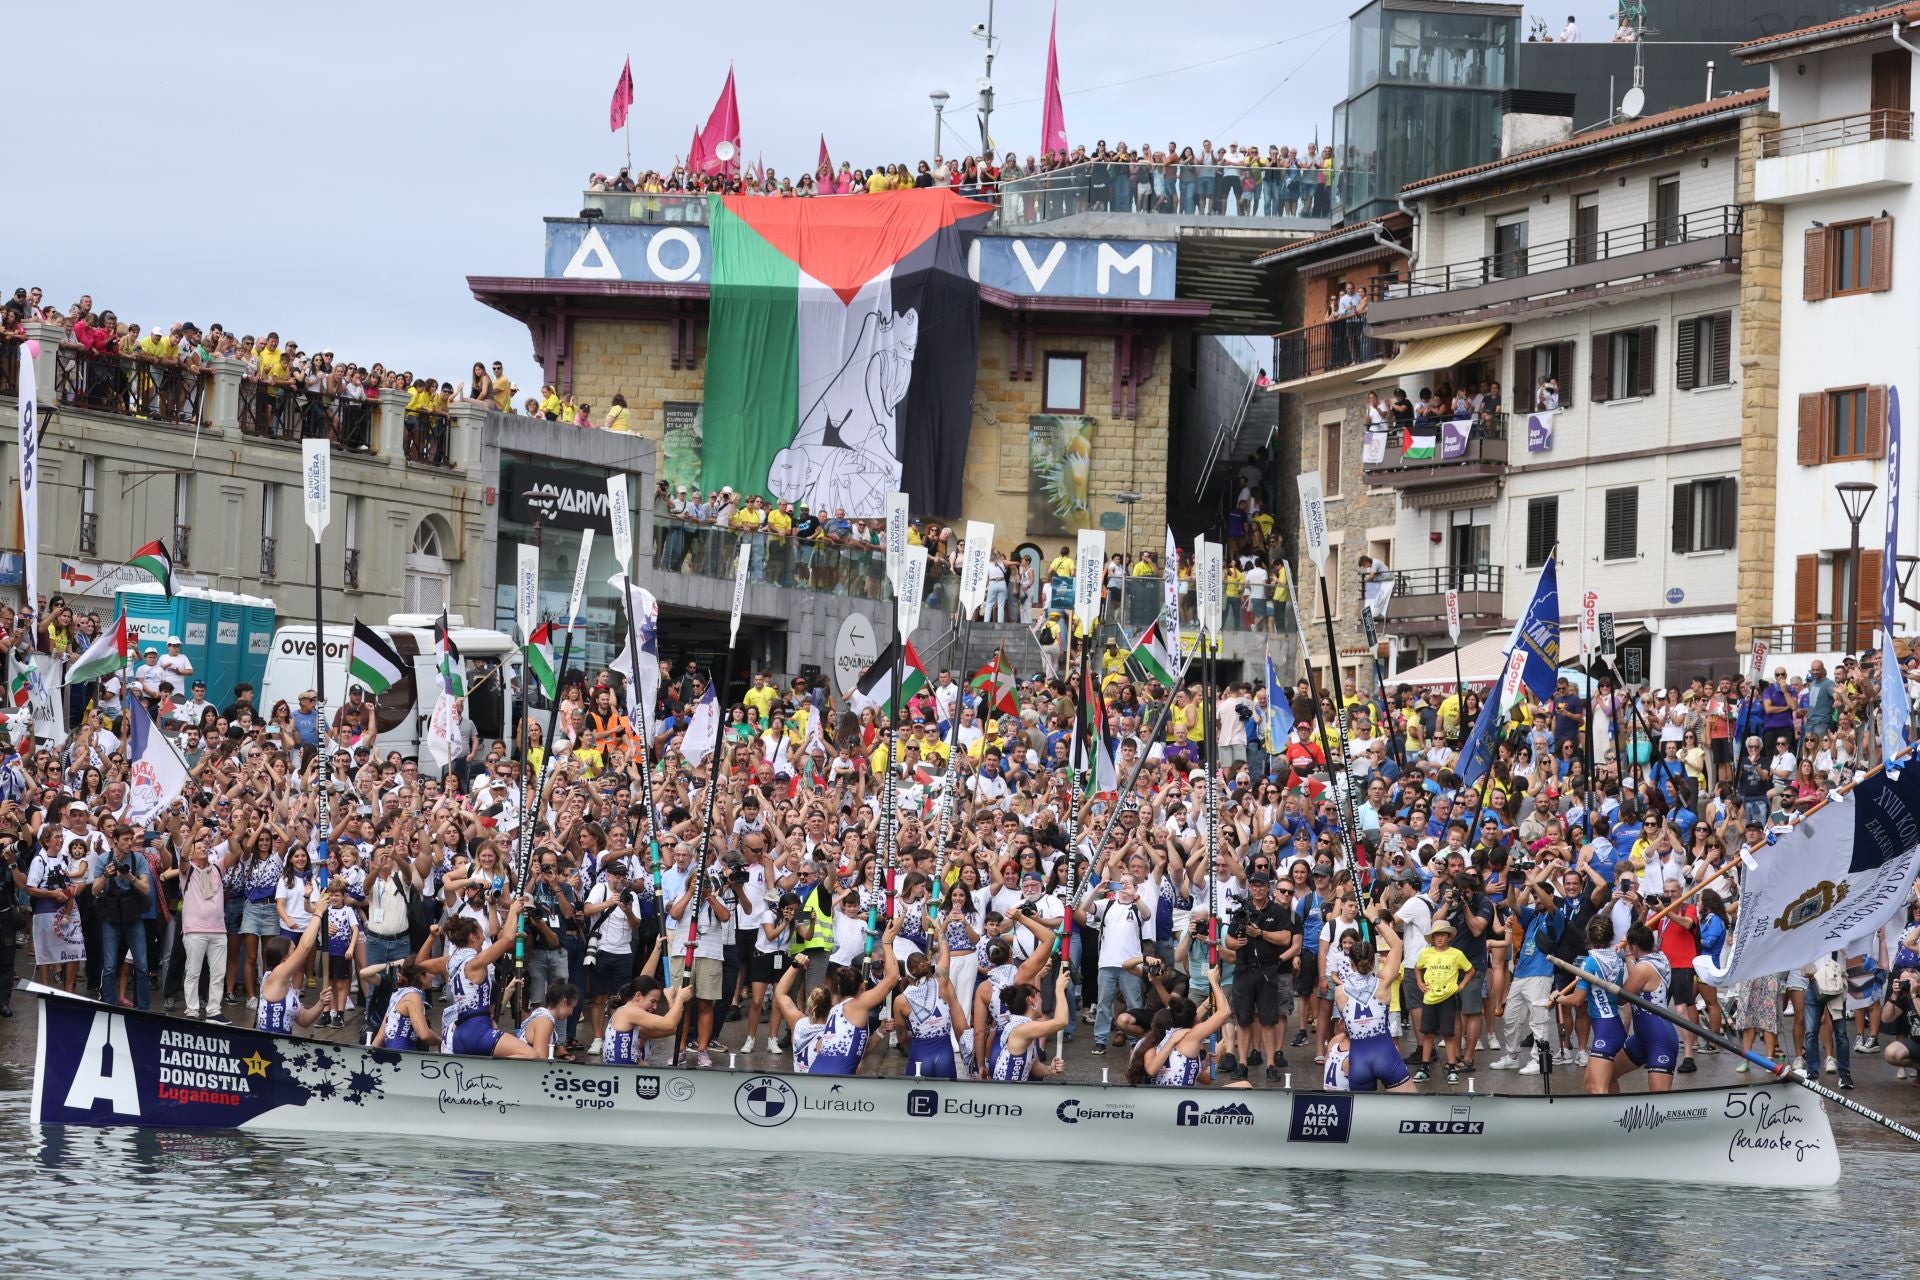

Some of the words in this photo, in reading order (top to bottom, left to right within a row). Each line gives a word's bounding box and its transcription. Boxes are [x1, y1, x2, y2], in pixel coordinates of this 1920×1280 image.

[1311, 502, 1321, 547] BAVIERA
[97, 565, 112, 579] Real
[115, 567, 133, 582] Club
[906, 559, 916, 603] BAVIERA
[1086, 559, 1094, 605] BAVIERA
[103, 583, 112, 595] de
[318, 701, 326, 740] LAGUNAK
[944, 745, 957, 795] DONOSTIA
[1071, 769, 1080, 817] DONOSTIA
[1873, 785, 1907, 820] XVIII
[320, 790, 328, 839] DONOSTIA
[940, 796, 950, 836] ARRAUN
[1069, 819, 1077, 859] ARRAUN
[934, 835, 946, 877] LAGUNAK
[1066, 861, 1076, 905] LAGUNAK
[1753, 915, 1769, 938] 2025
[454, 973, 465, 995] A
[272, 1003, 283, 1028] asegi
[1353, 1002, 1374, 1020] A
[825, 1013, 836, 1034] A
[160, 1030, 231, 1054] ARRAUN
[620, 1033, 630, 1058] asegi
[857, 1030, 867, 1056] asegi
[64, 1011, 141, 1116] A
[159, 1049, 241, 1075] LAGUNAK
[250, 1059, 264, 1073] 11
[1011, 1057, 1025, 1081] asegi
[1187, 1059, 1198, 1086] asegi
[1325, 1062, 1338, 1086] A
[159, 1068, 250, 1092] DONOSTIA
[555, 1076, 619, 1096] asegi
[743, 1078, 791, 1095] BMW
[1802, 1078, 1846, 1104] LAGUNAK
[575, 1098, 615, 1109] grupo
[804, 1096, 875, 1113] Lurauto
[944, 1098, 1022, 1118] Edyma
[1306, 1103, 1338, 1116] ARA
[1666, 1107, 1708, 1120] ENSANCHE
[1845, 1098, 1883, 1122] ARRAUN
[1302, 1126, 1328, 1137] DIA
[1304, 1115, 1339, 1127] MEN
[1401, 1121, 1482, 1134] DRUCK
